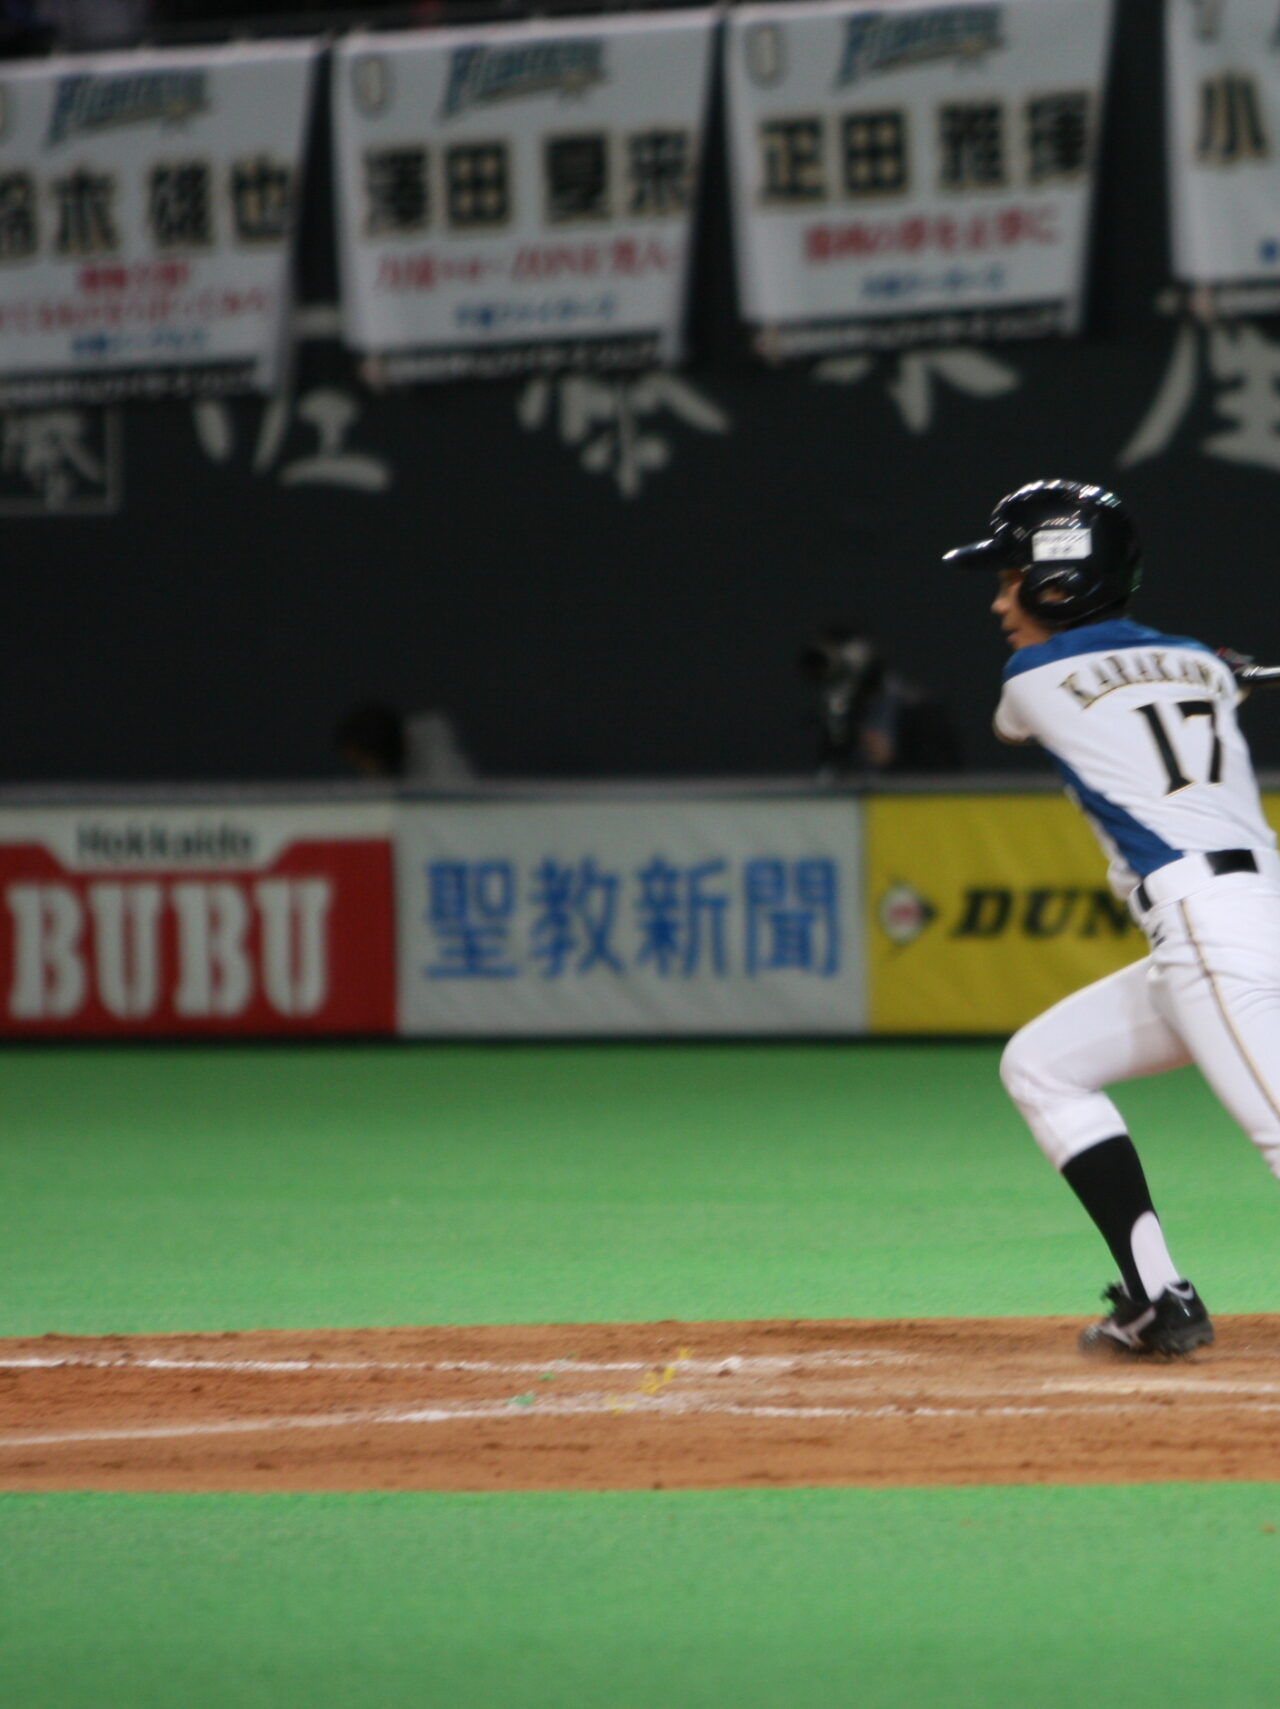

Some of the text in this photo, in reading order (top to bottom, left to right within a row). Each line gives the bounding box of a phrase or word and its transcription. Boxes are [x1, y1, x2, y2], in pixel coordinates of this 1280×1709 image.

[1132, 698, 1223, 797] 17
[76, 821, 256, 863] Hokkaido
[6, 876, 333, 1021] BUBU
[424, 855, 841, 979] 聖教新聞
